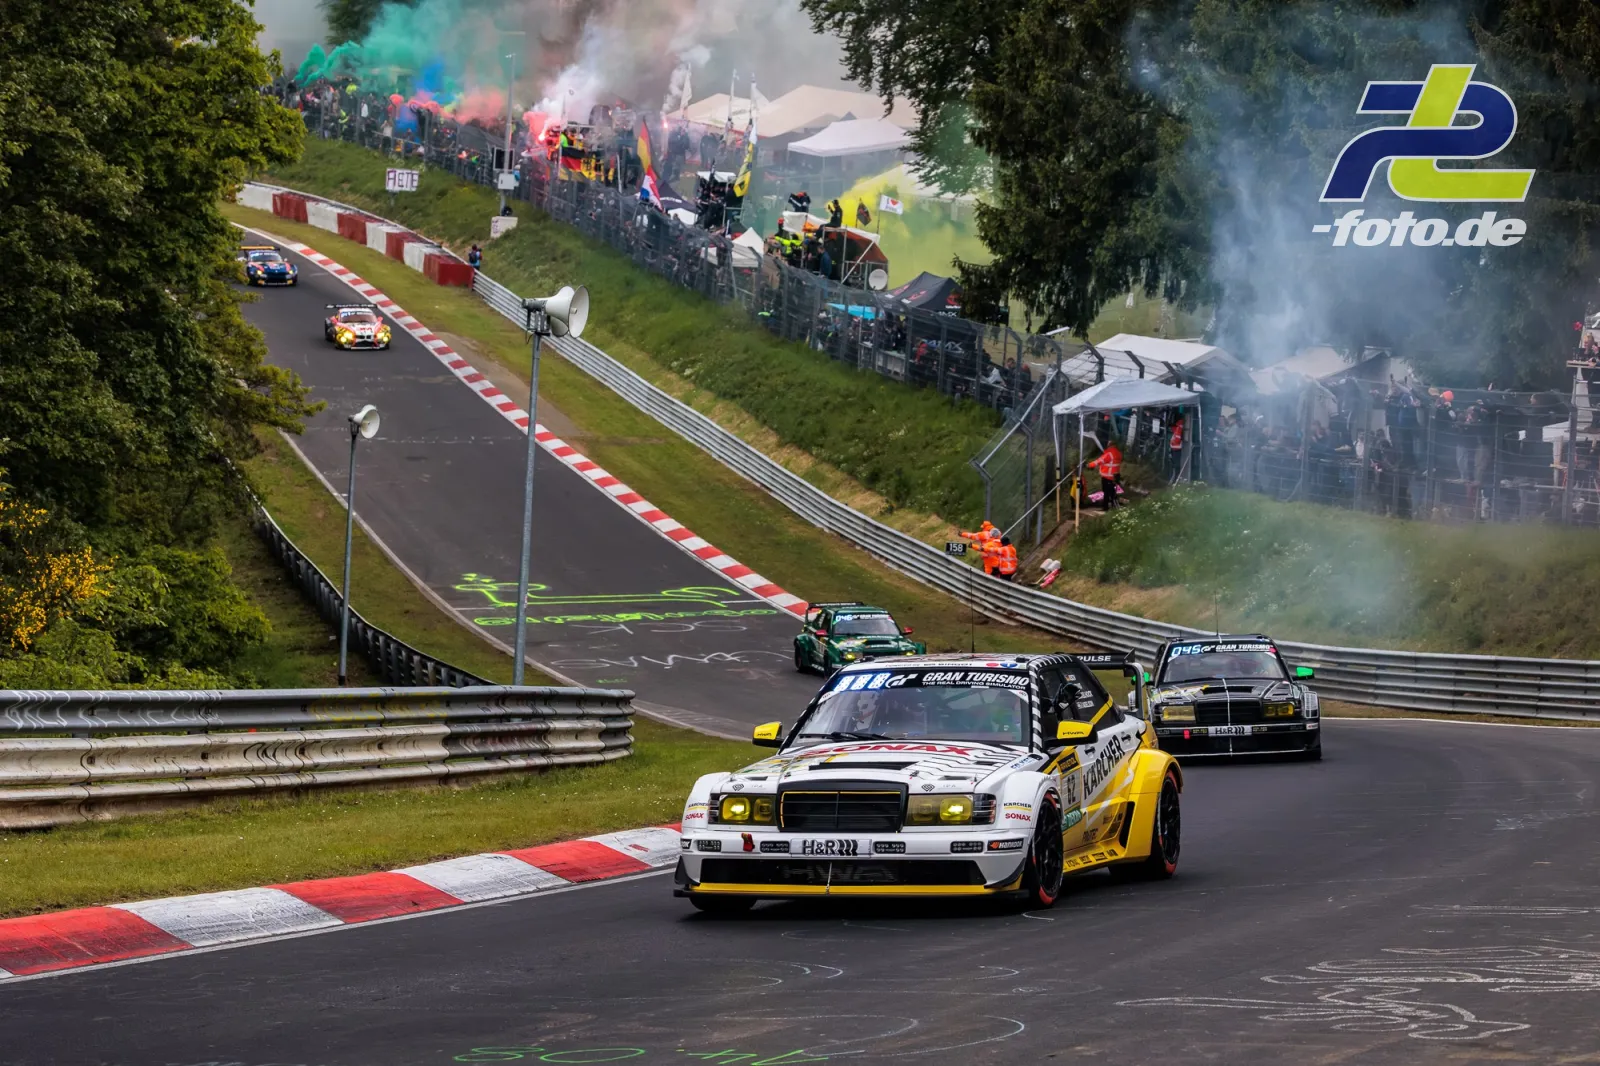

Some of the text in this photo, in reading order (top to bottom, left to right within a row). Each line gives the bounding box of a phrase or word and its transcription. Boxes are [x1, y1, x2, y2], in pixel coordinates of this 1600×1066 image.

[949, 543, 963, 552] 158
[922, 671, 1029, 686] GRAN TURISMO
[985, 681, 1026, 690] SIMULATOR
[1215, 727, 1234, 735] H&R
[800, 744, 977, 757] SONAX
[684, 812, 705, 821] SONAX
[1004, 812, 1031, 822] SONAX
[802, 839, 837, 856] H&R
